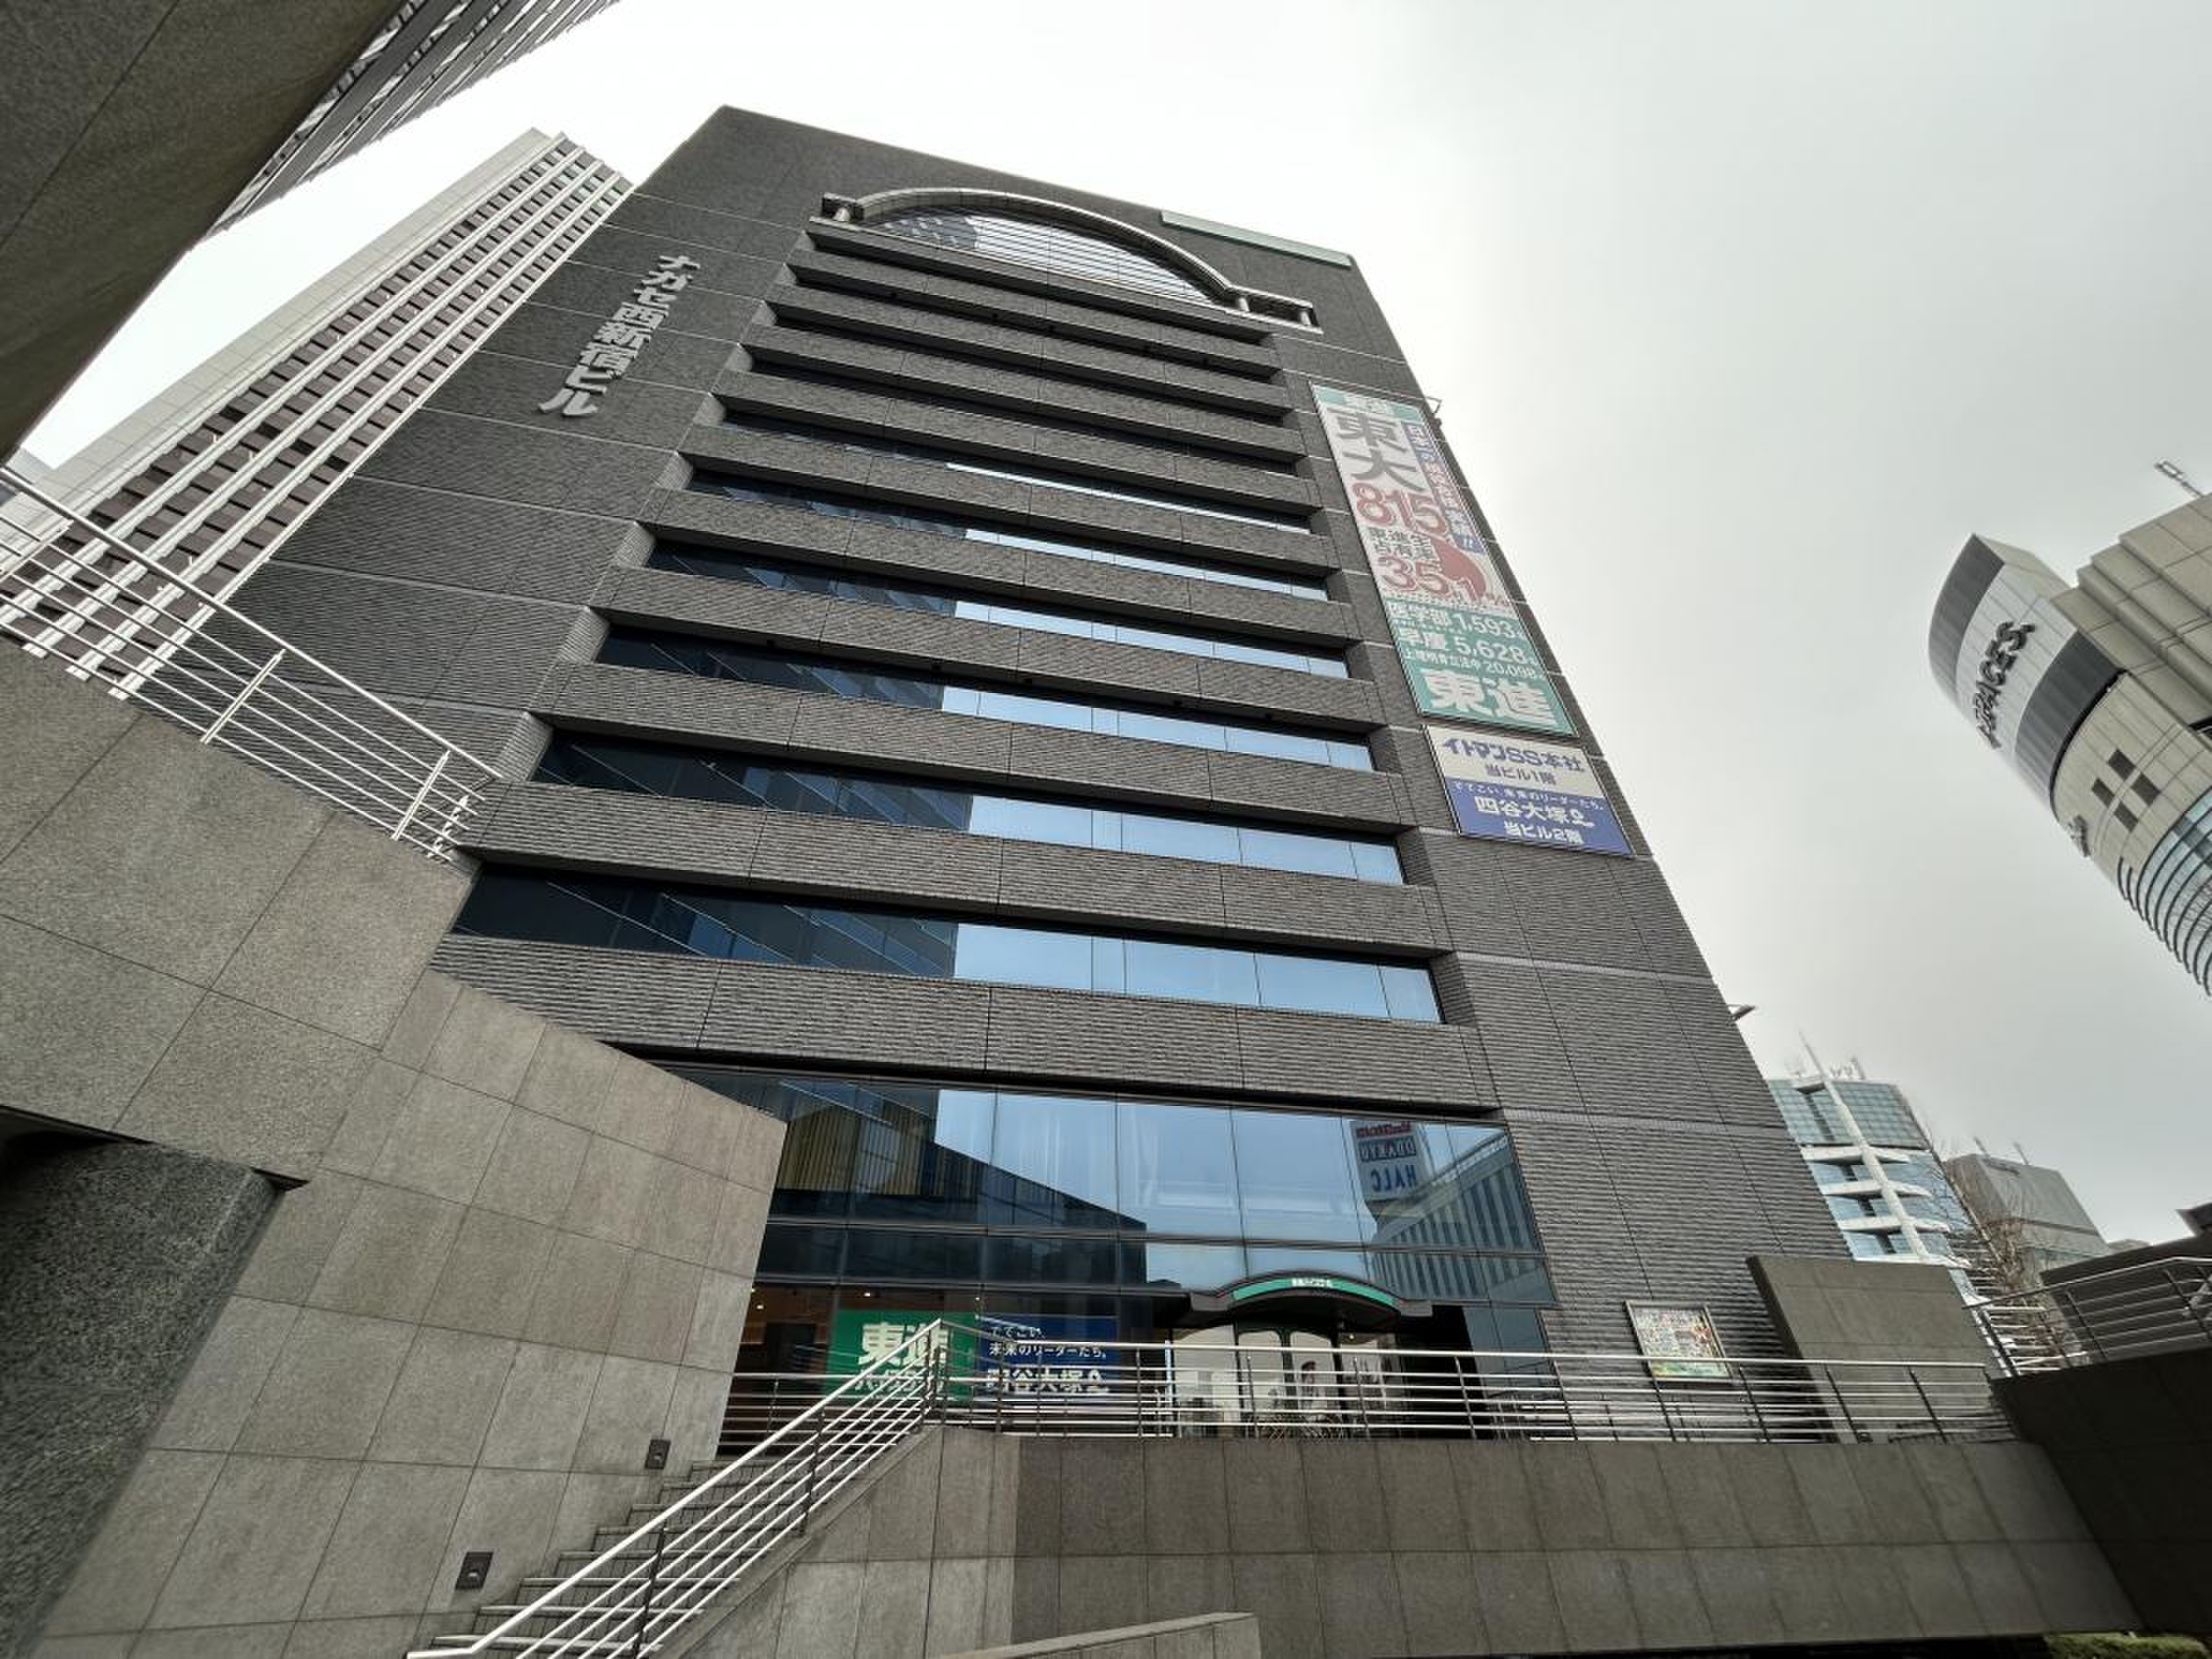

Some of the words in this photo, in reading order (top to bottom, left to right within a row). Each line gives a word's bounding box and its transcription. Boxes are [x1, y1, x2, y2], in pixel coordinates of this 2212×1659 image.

[536, 255, 701, 417] ナガセ西新宿ビル
[1326, 407, 1425, 491] 東大
[1351, 481, 1448, 536] 815
[1420, 667, 1559, 726] 東進
[1443, 737, 1586, 773] イトマンSS本社
[1484, 763, 1558, 785] 当ビル1階
[1475, 796, 1571, 825] 四谷大塚
[1504, 821, 1583, 845] 当ビル2階
[858, 1322, 949, 1367] 東進
